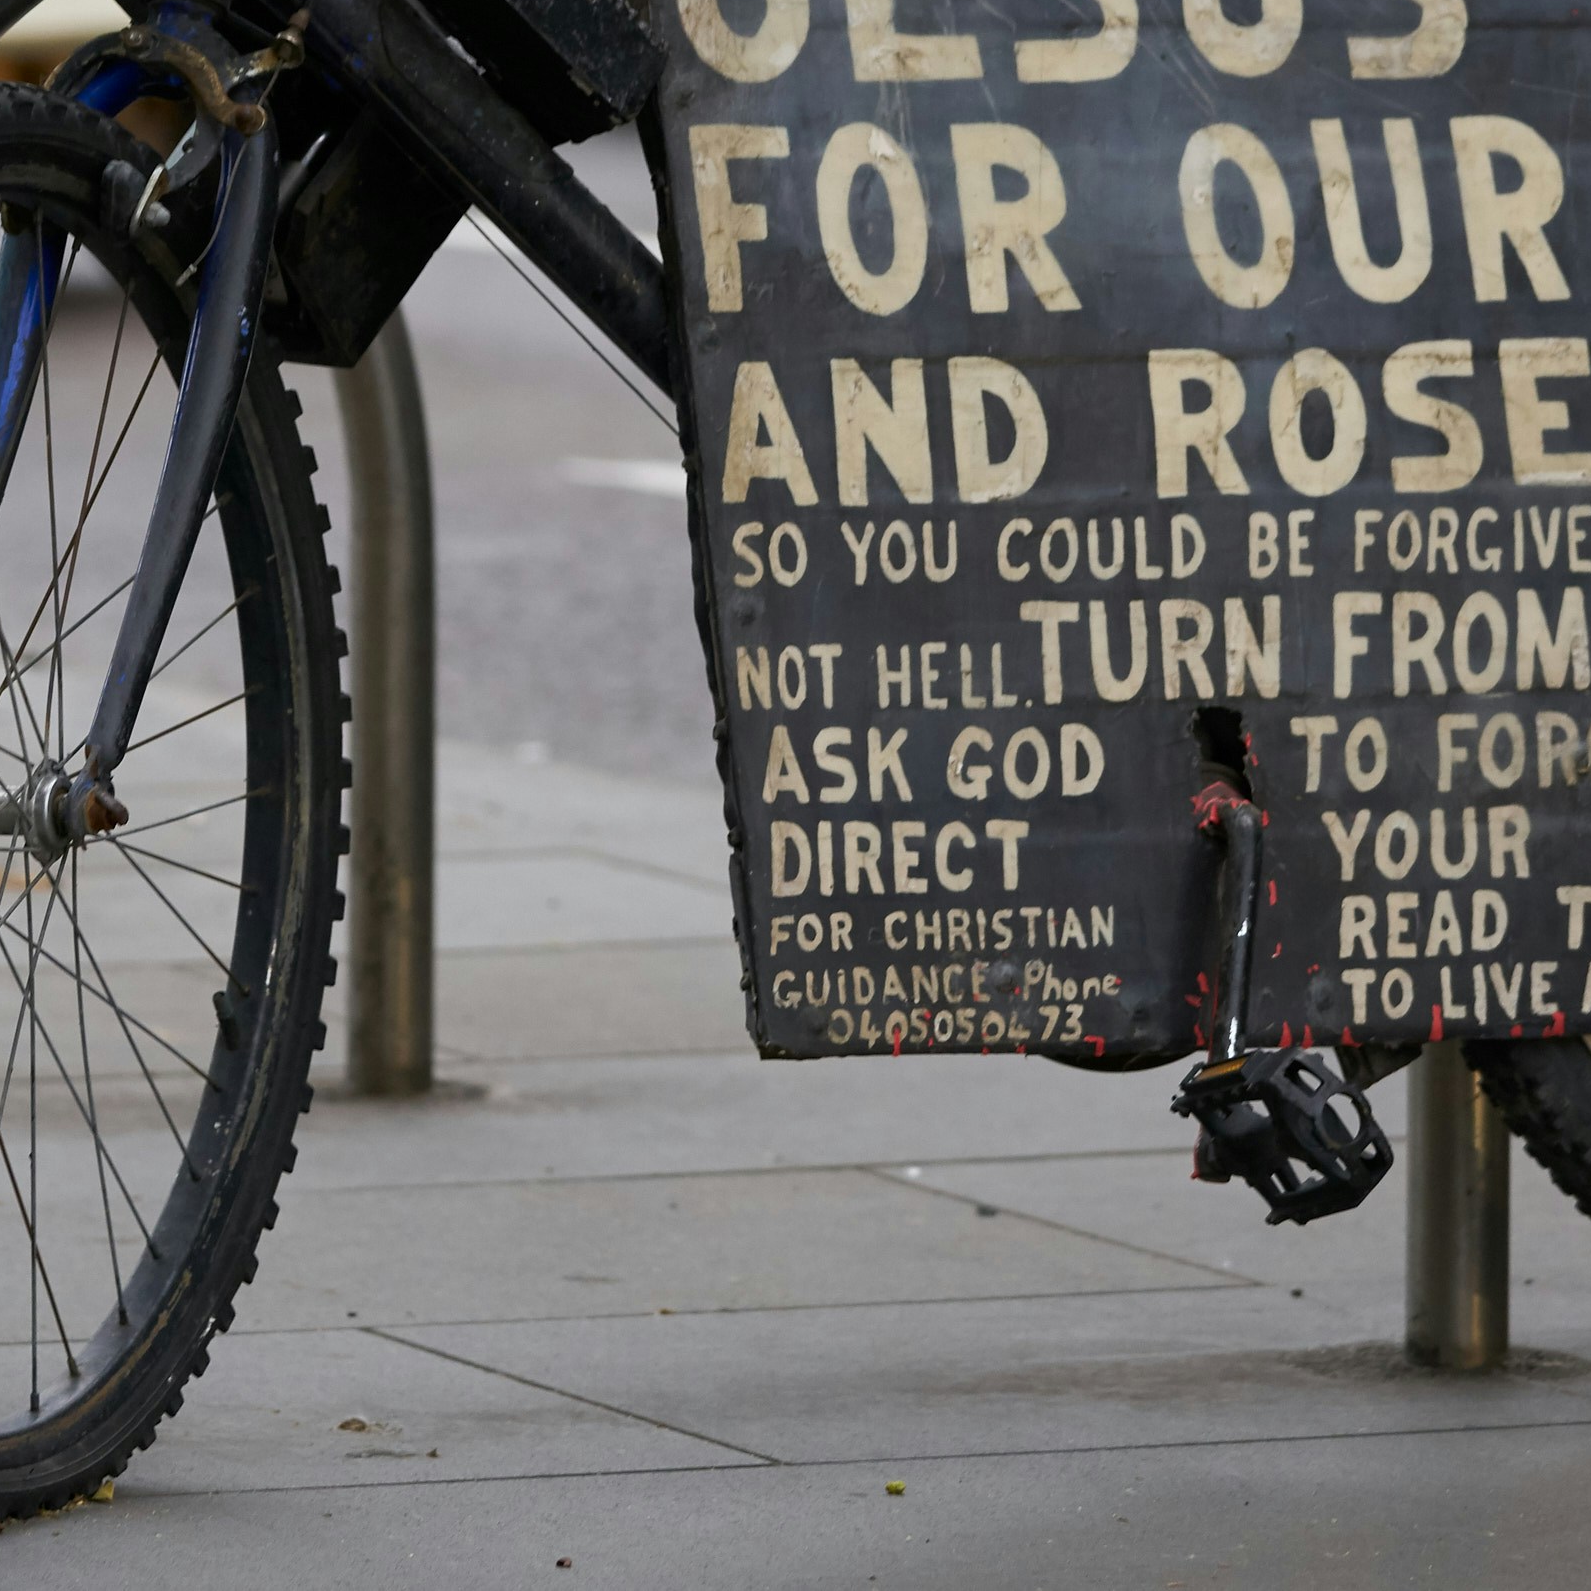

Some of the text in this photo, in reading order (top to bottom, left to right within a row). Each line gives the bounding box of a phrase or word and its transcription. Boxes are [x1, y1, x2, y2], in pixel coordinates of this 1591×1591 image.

[688, 120, 1083, 318] FOR
[1177, 114, 1572, 311] OUR
[721, 355, 1049, 508] AND
[731, 521, 808, 588] SO
[840, 519, 958, 586] YOU
[996, 513, 1207, 584] COULD
[1248, 508, 1315, 580] BE
[736, 643, 843, 711] NOT
[1019, 594, 1282, 705] TURN
[1332, 586, 1591, 700] FROM
[762, 724, 913, 804] ASK
[946, 722, 1105, 801] GOD
[1289, 714, 1389, 793] TO
[770, 818, 1030, 898] DIRECT
[1321, 804, 1532, 882] YOUR
[770, 905, 1114, 956] FOR CHRISTIAN
[1339, 889, 1509, 960] READ
[1022, 959, 1119, 1002] Phone
[1341, 967, 1414, 1025] TO
[1440, 960, 1558, 1025] LIVE
